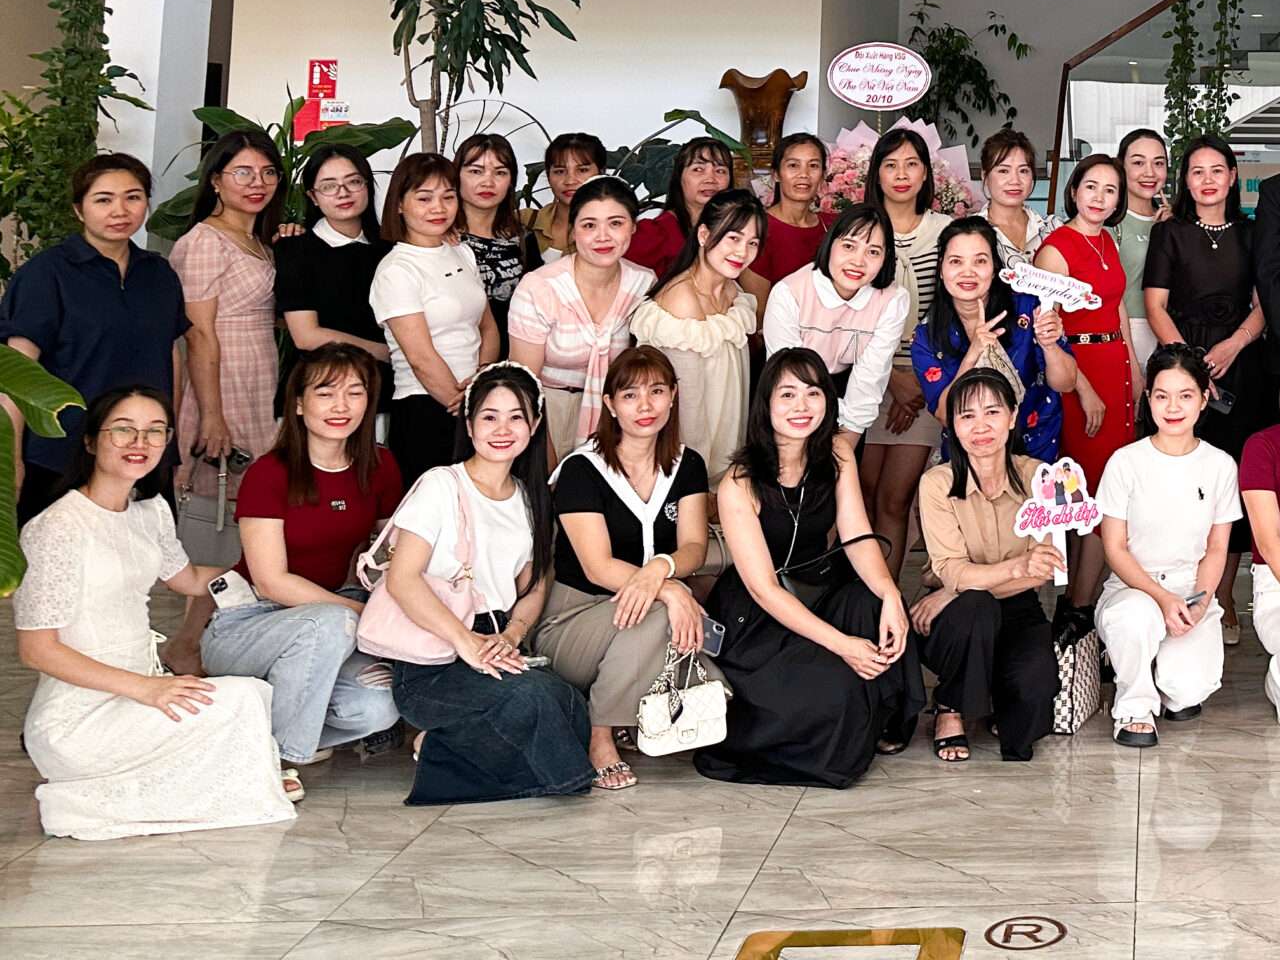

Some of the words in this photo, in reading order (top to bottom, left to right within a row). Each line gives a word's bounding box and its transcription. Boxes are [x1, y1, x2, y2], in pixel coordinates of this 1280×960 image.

[866, 94, 893, 104] 20/10
[1016, 274, 1081, 306] Everyday
[1019, 502, 1051, 531] Hội
[1052, 504, 1074, 527] chị
